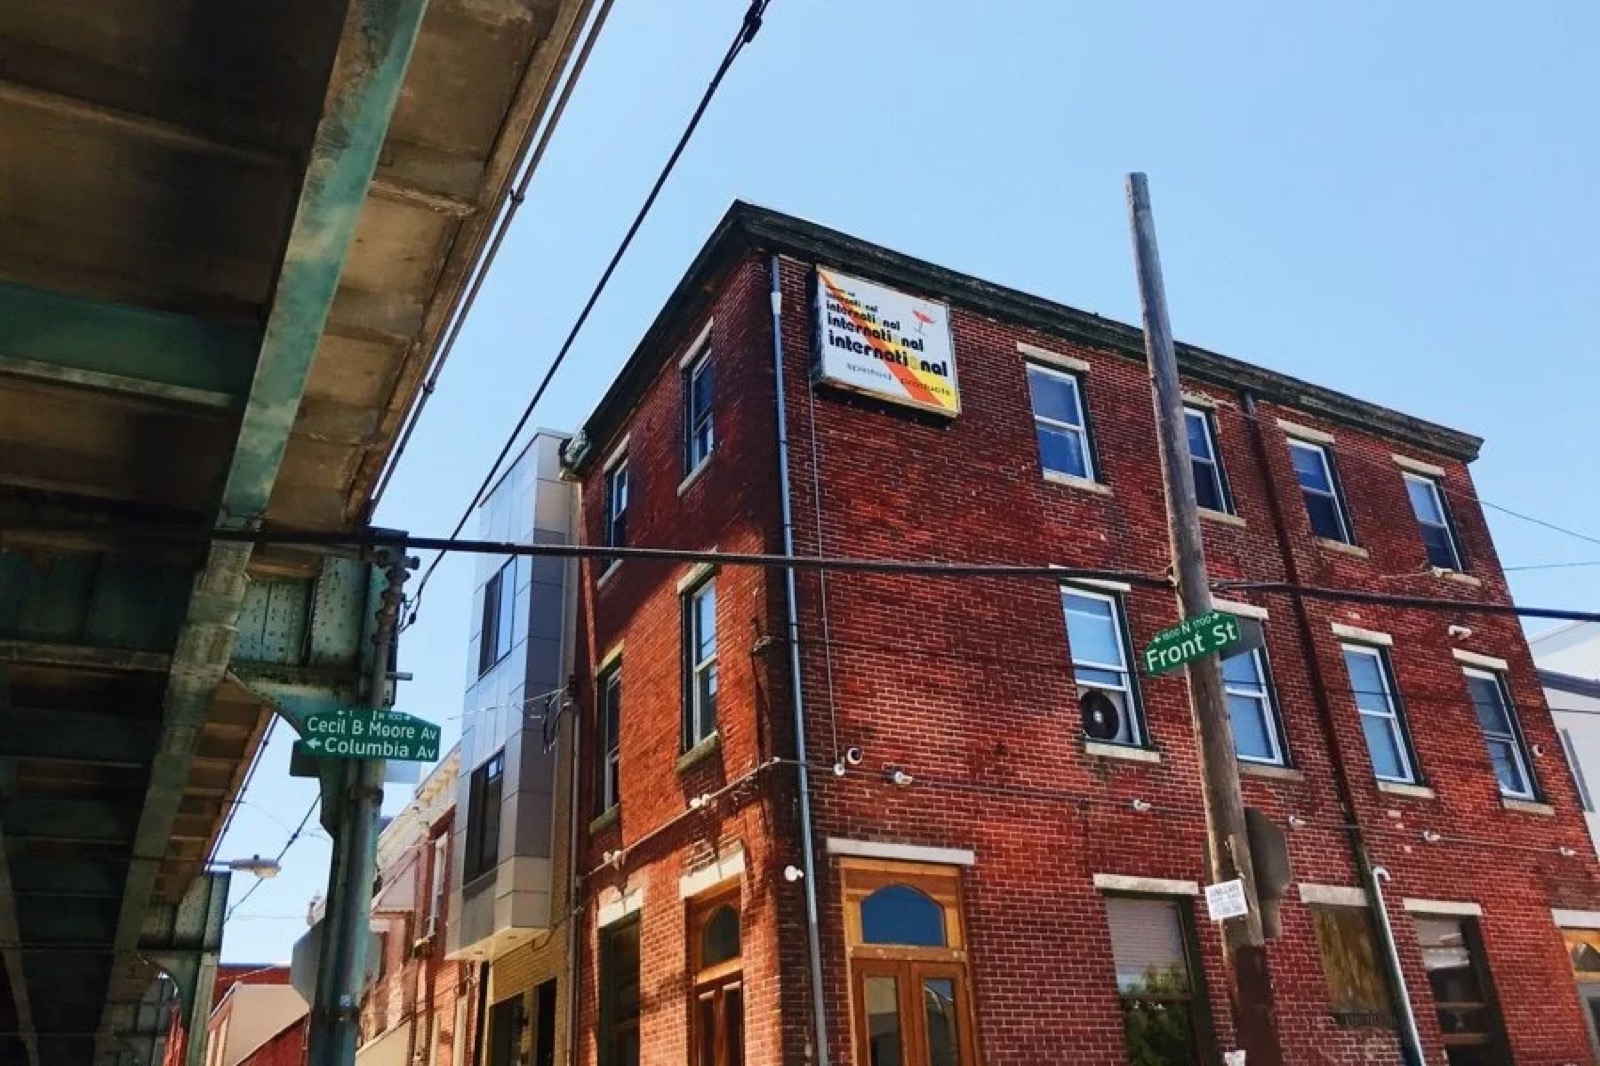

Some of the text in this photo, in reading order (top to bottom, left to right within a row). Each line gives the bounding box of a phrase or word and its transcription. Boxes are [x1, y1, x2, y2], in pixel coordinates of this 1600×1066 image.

[826, 299, 900, 331] internatinal
[827, 312, 924, 352] internatinal
[1182, 622, 1191, 635] N
[1146, 621, 1238, 673] Front St
[307, 716, 346, 735] Cecil
[369, 721, 415, 739] Moore
[421, 726, 438, 740] Av
[324, 737, 437, 760] Columbia Av
